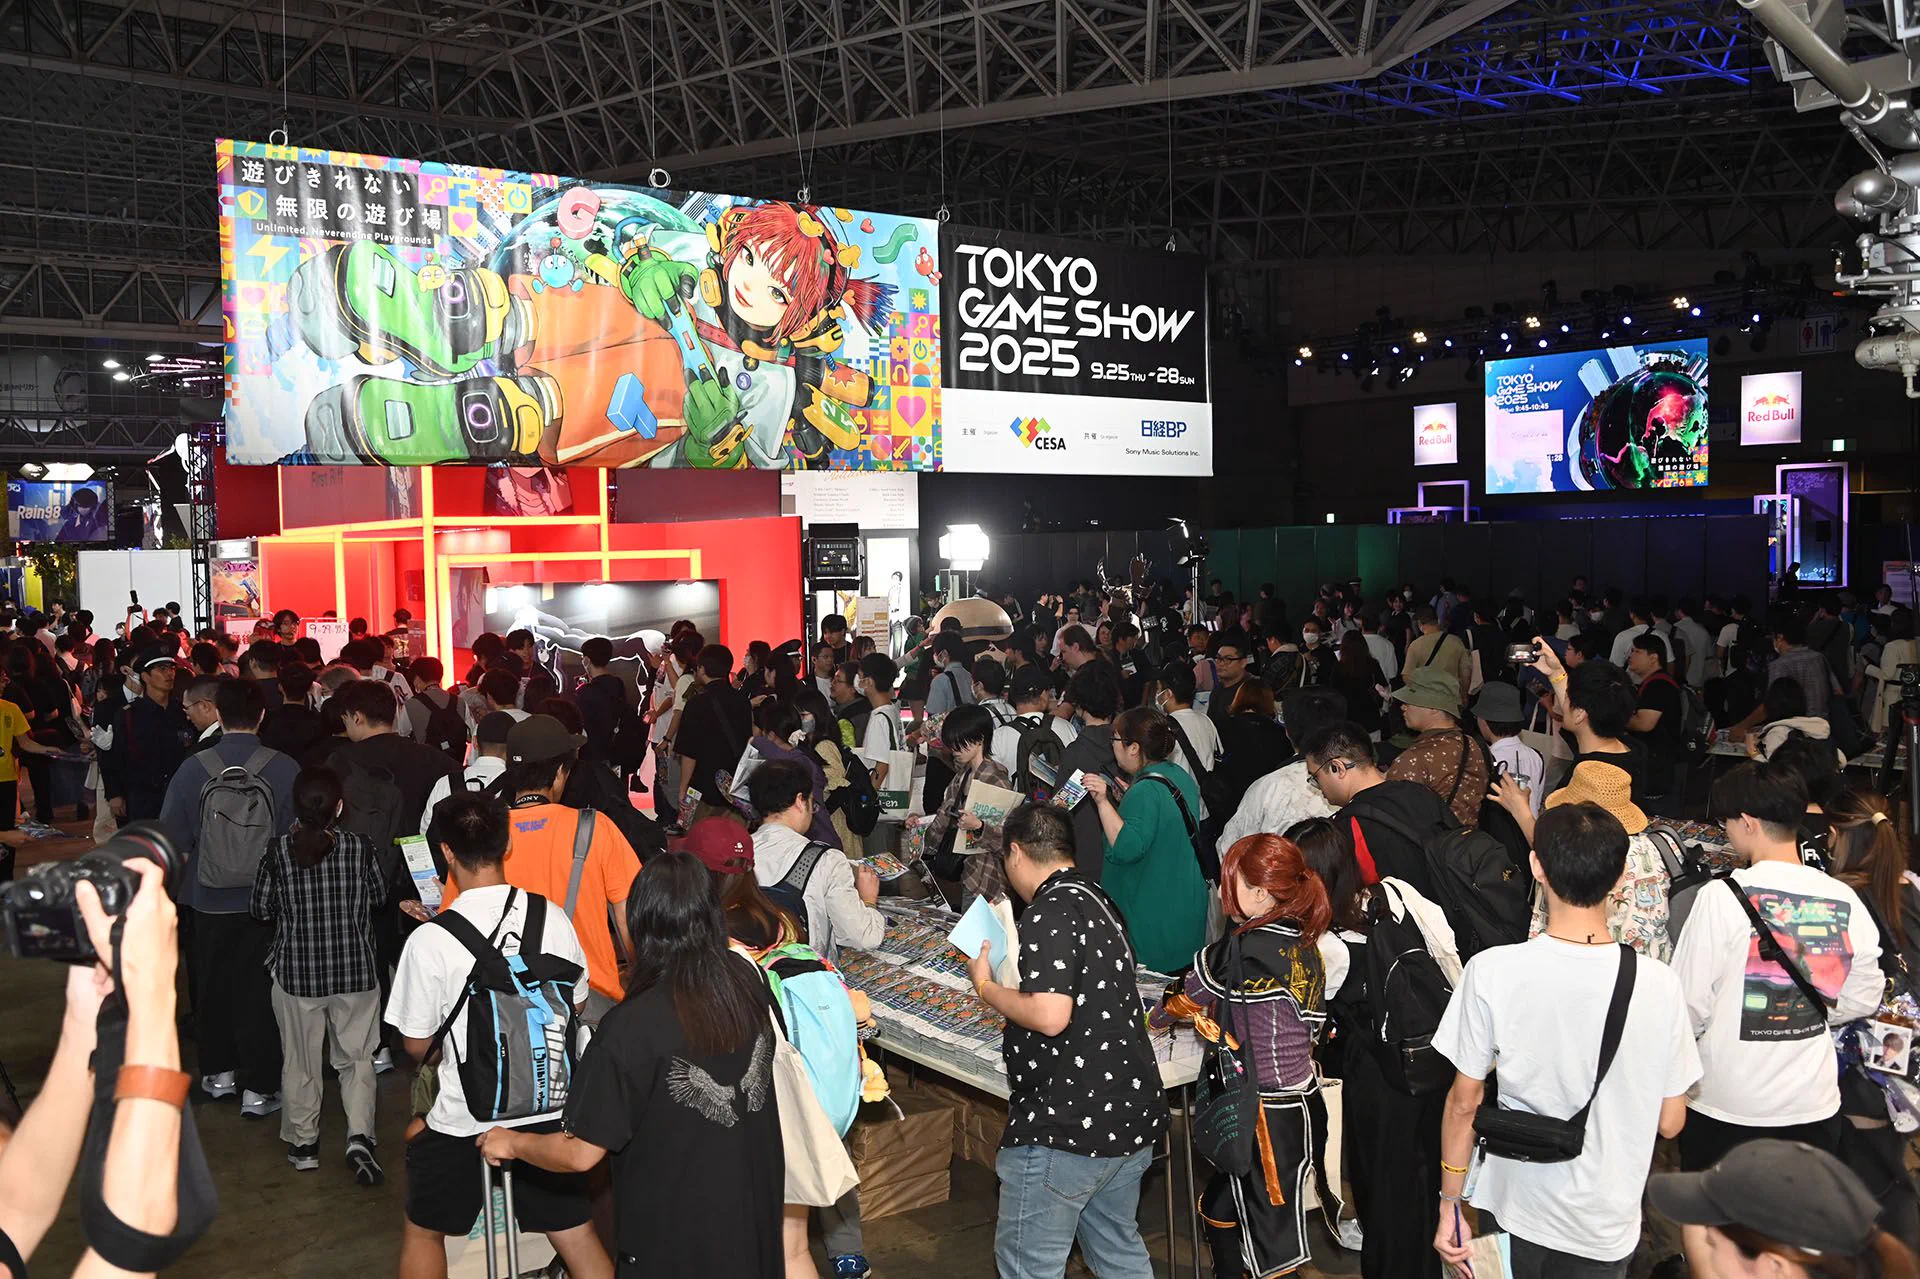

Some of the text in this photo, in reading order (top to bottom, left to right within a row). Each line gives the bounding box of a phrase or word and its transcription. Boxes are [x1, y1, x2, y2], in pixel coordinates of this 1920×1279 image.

[241, 160, 411, 196] 遊びきれない
[275, 194, 443, 231] 無限の遊び場
[256, 222, 309, 235] Unlimited,
[374, 232, 432, 245] Playgrounds
[955, 244, 1098, 296] TOKYO
[958, 287, 1195, 343] GAME SHOW
[959, 331, 1080, 377] 2025
[1496, 373, 1533, 386] TOKYO
[1496, 380, 1562, 396] GAME SHOW
[1496, 394, 1528, 406] 2025
[1748, 408, 1794, 422] Red Bull
[1141, 419, 1187, 438] 日経BP
[1035, 437, 1066, 450] CESA
[1419, 434, 1452, 446] Red Bull
[1125, 448, 1140, 457] Sony
[1142, 448, 1159, 456] Music
[1161, 449, 1189, 457] Solutions
[17, 504, 62, 520] Rain98
